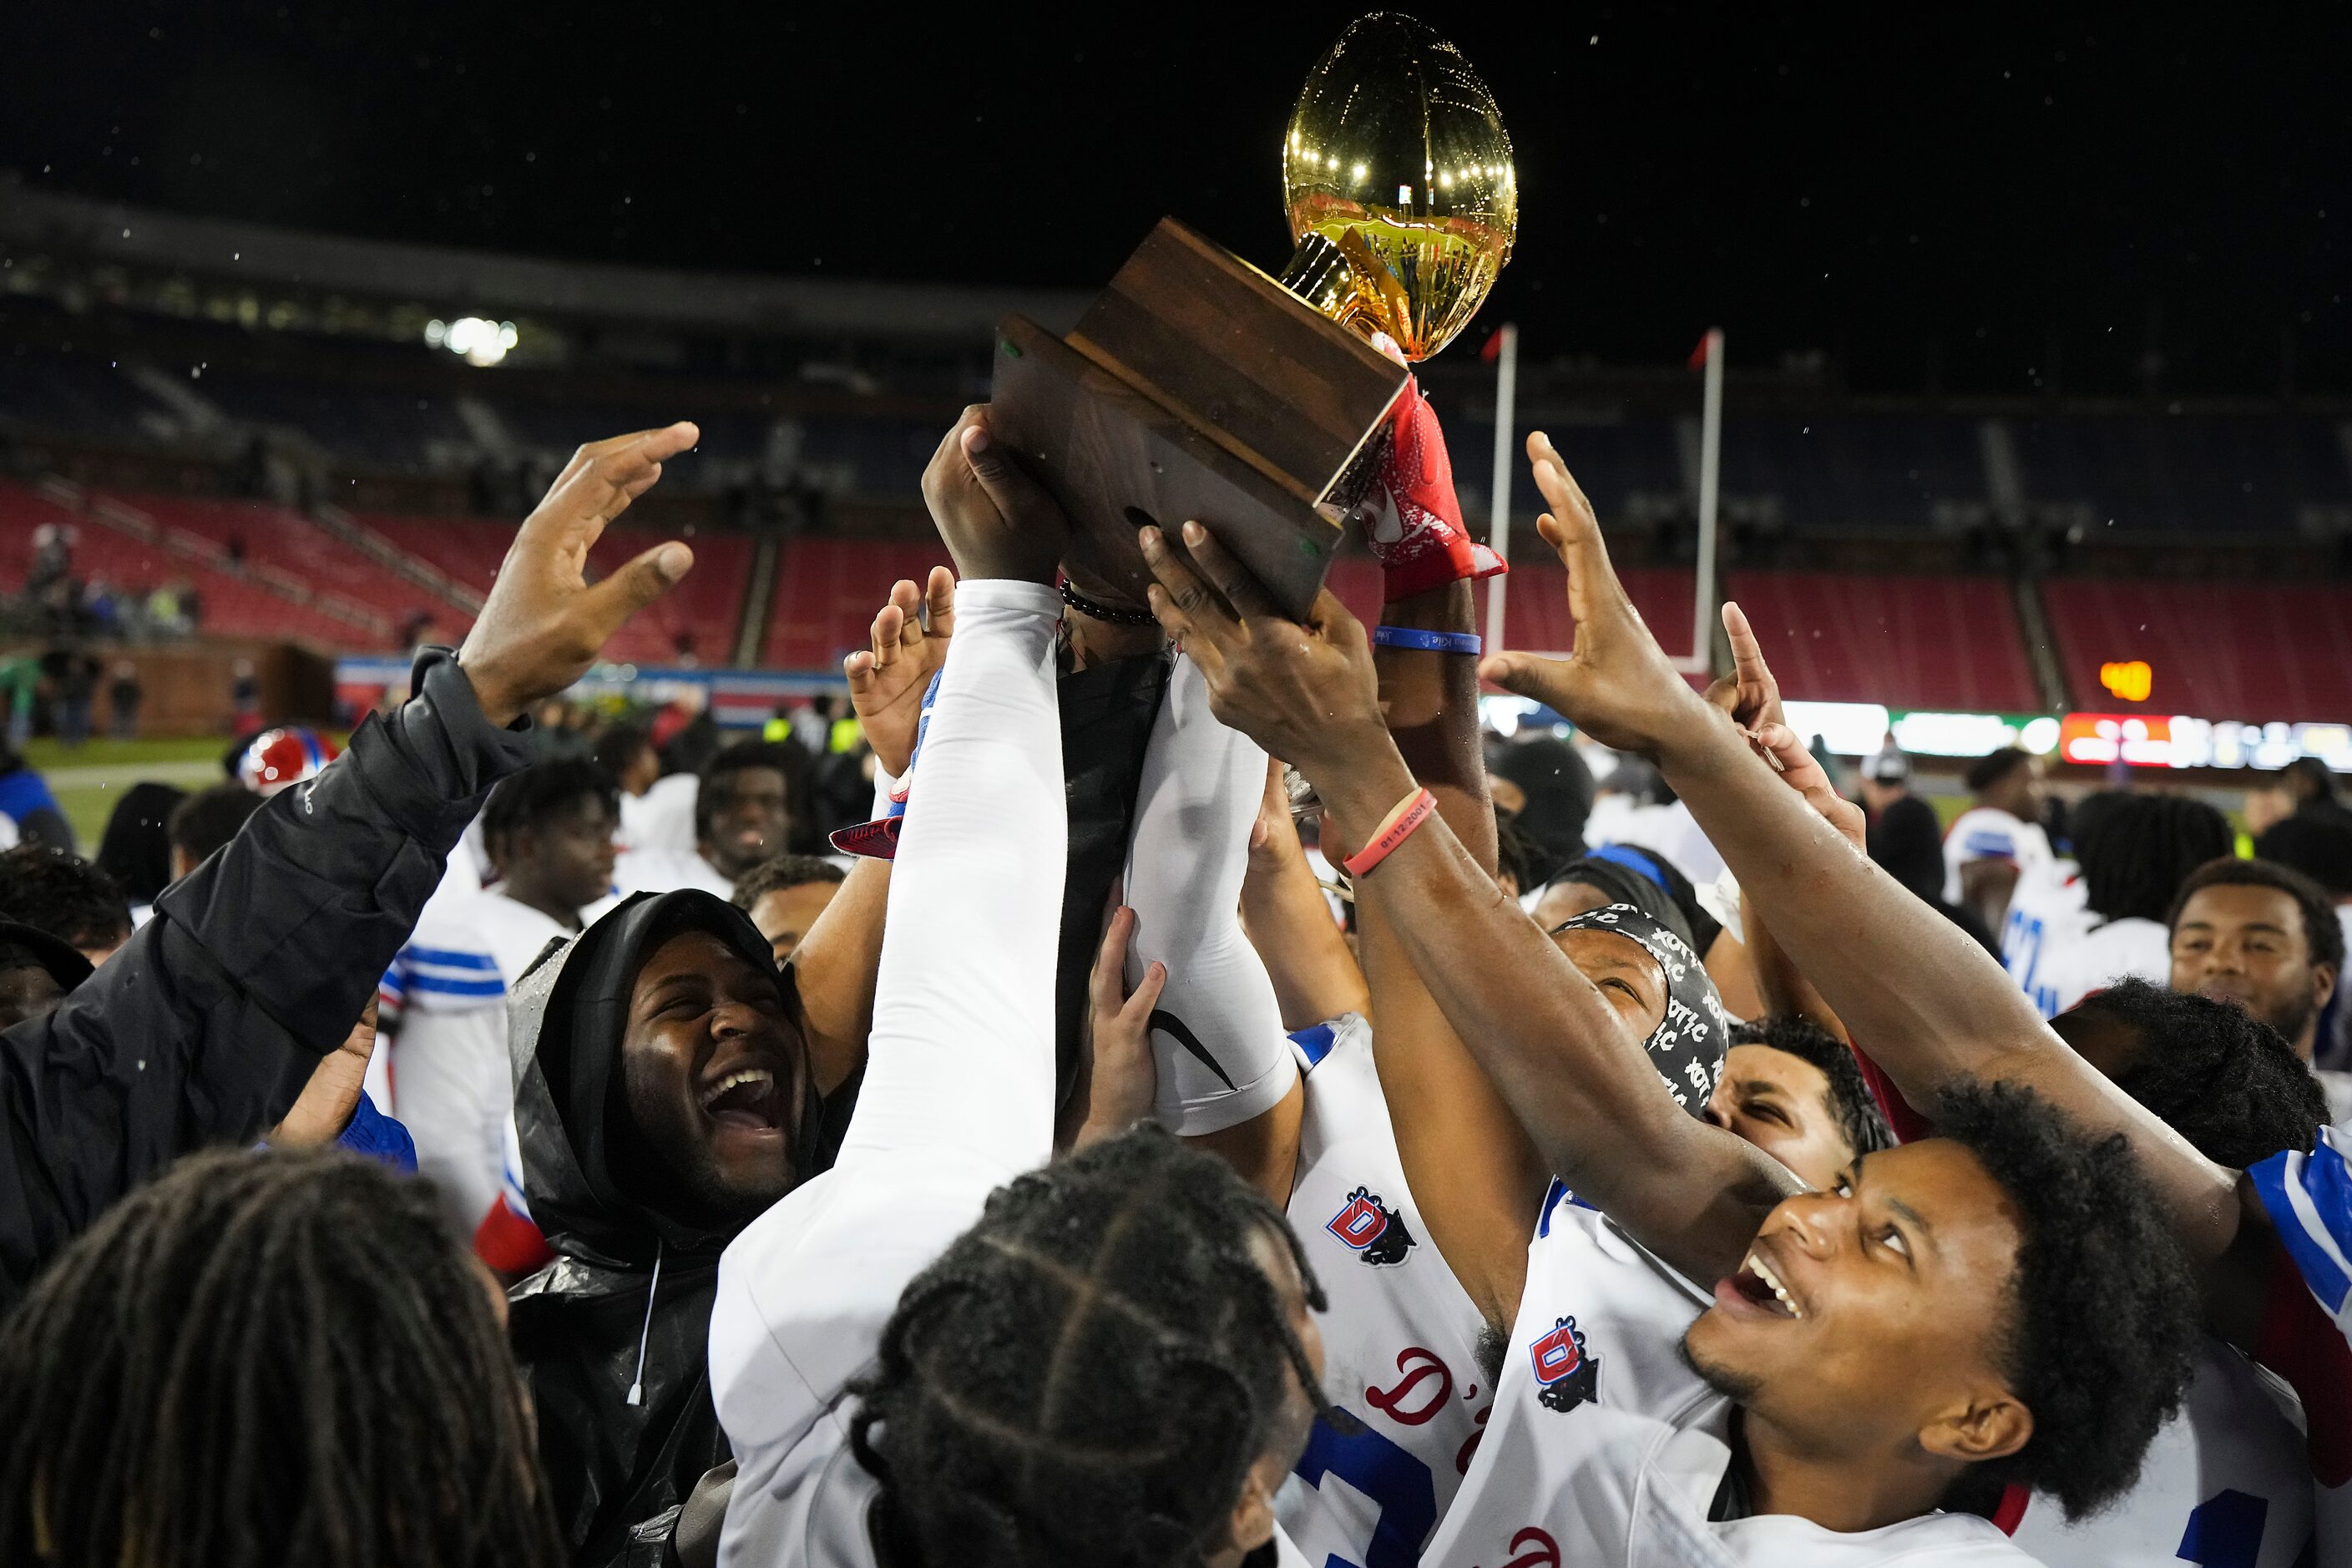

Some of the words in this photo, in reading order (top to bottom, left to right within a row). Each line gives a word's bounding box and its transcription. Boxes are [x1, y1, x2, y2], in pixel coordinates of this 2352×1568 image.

[1667, 995, 1709, 1043] OTIC
[1325, 1195, 1389, 1250] D
[1529, 1323, 1582, 1386] D
